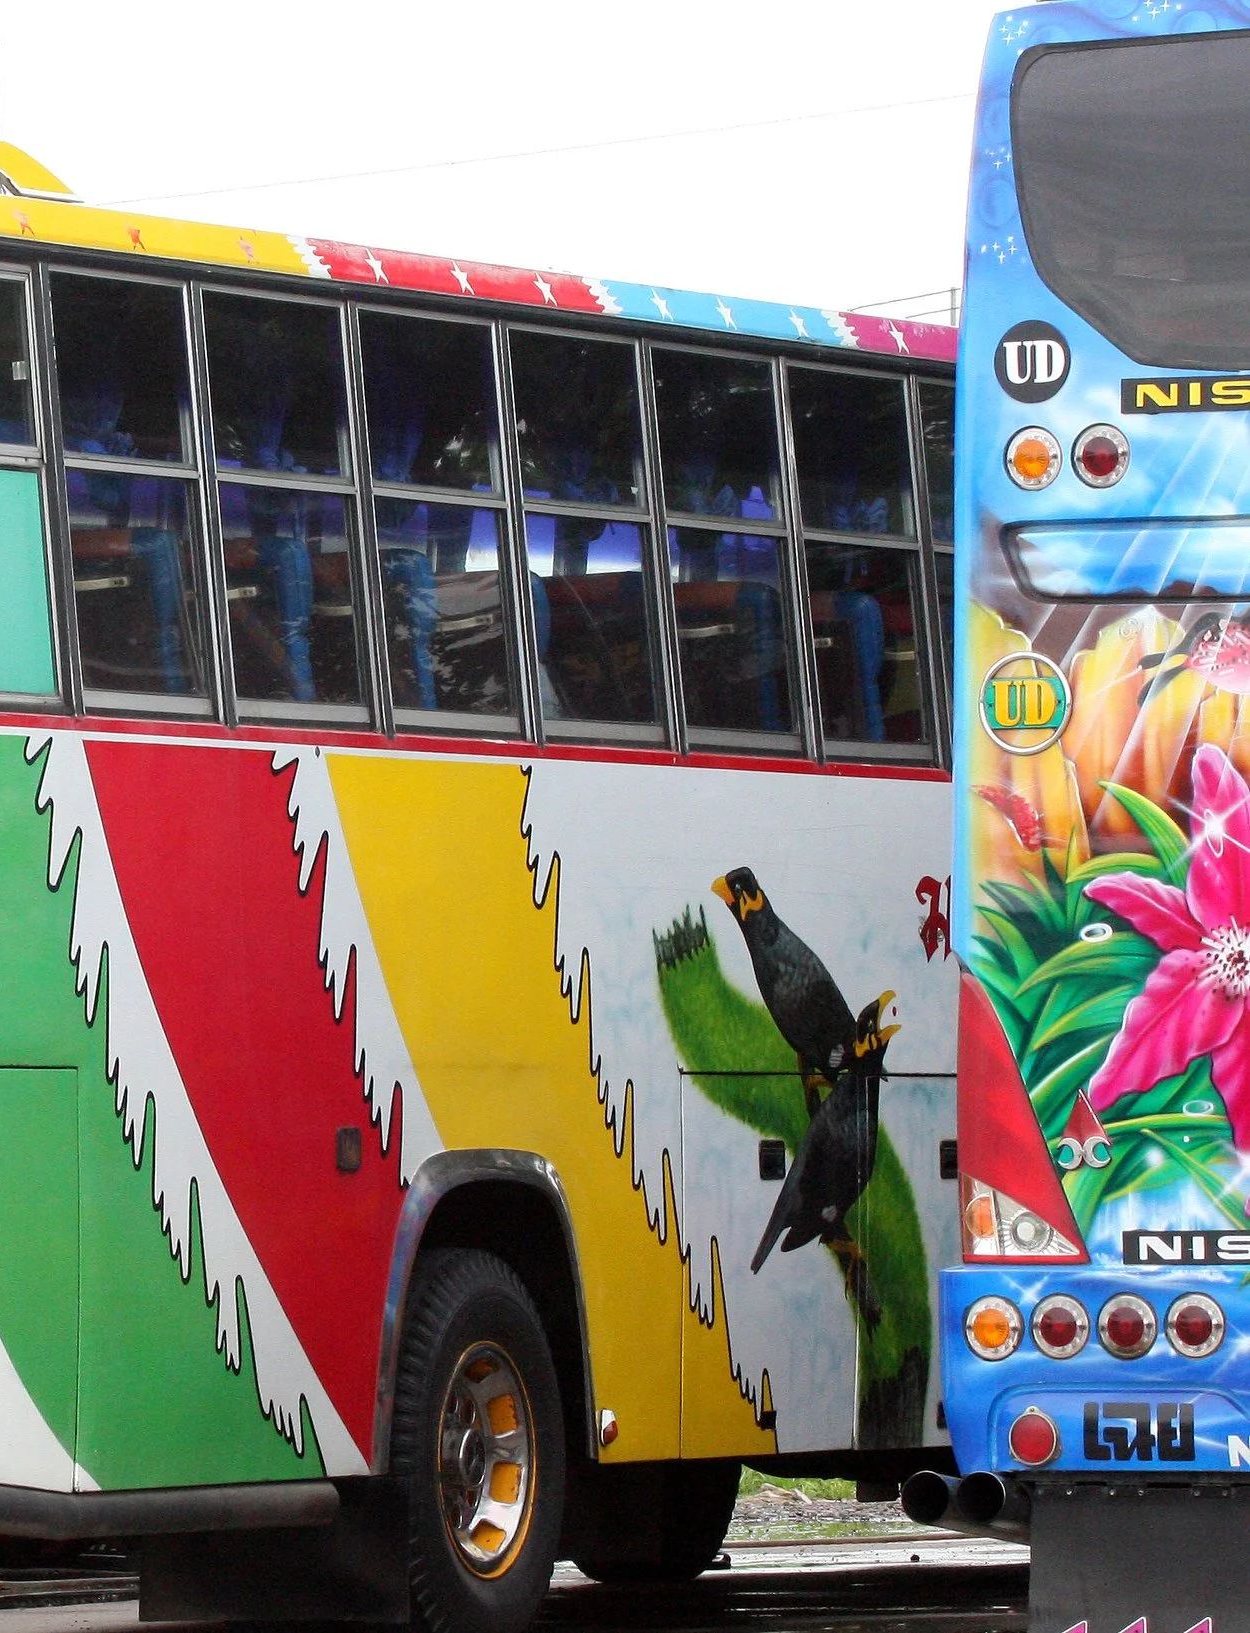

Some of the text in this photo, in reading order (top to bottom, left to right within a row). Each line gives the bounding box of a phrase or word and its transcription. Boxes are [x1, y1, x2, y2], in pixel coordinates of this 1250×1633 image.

[1003, 340, 1065, 384] UD
[1137, 380, 1250, 408] NIS
[992, 680, 1057, 727] UD
[1138, 1235, 1250, 1261] NIS
